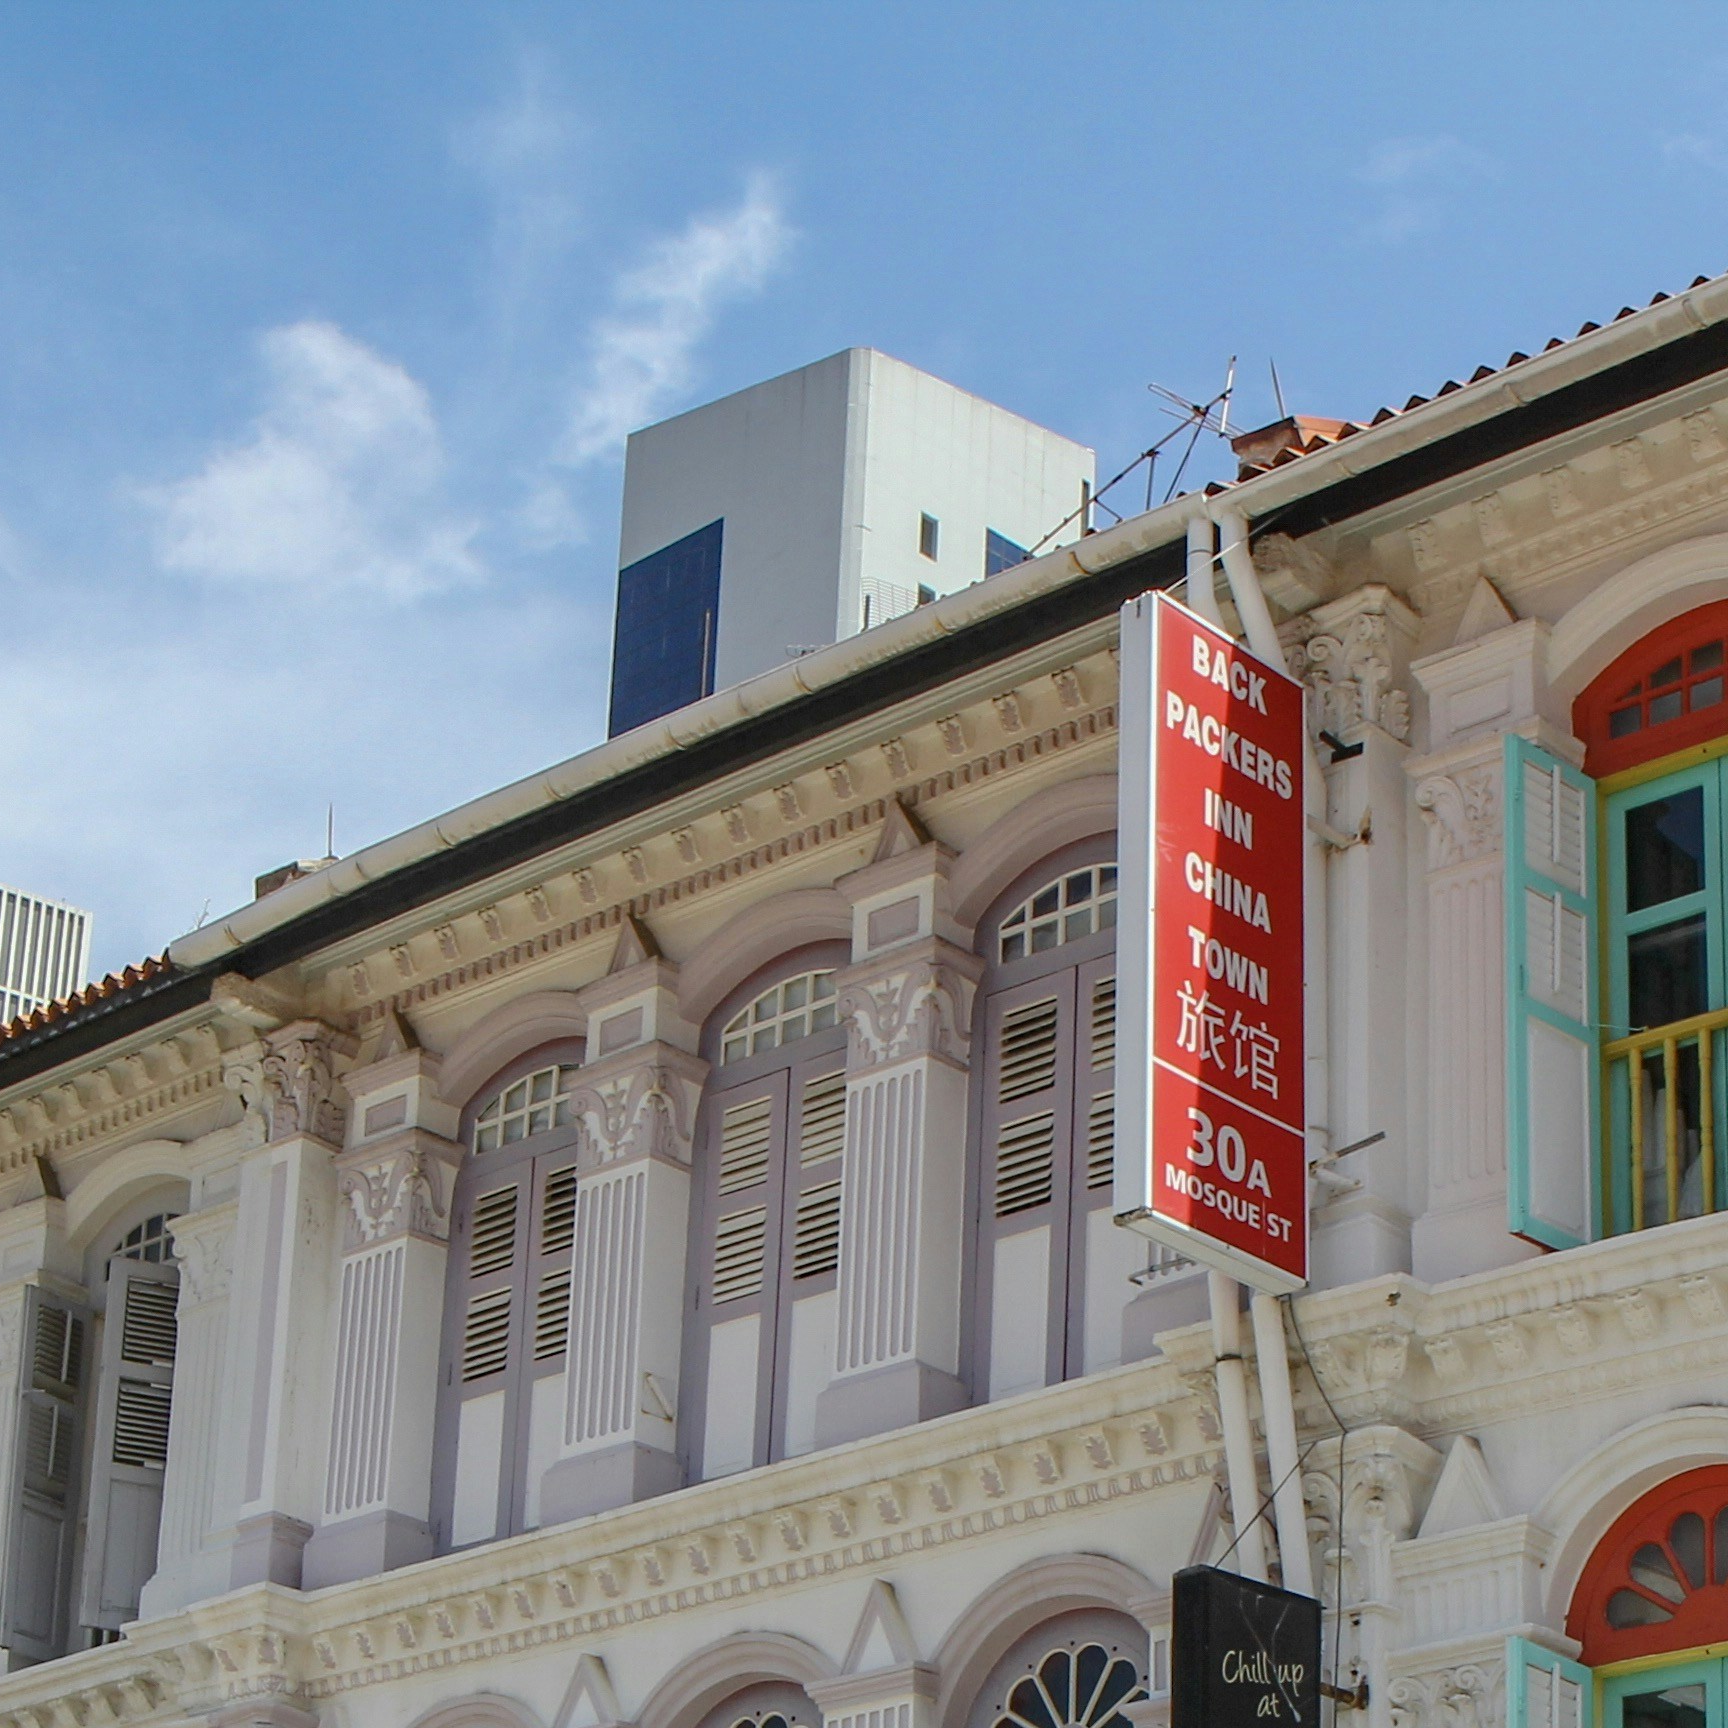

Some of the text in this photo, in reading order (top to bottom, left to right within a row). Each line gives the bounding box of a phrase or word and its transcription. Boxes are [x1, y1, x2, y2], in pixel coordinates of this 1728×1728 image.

[1192, 634, 1267, 717] BACK
[1166, 690, 1293, 800] PACKERS
[1204, 787, 1253, 850] INN
[1185, 852, 1272, 935] CHINA
[1187, 925, 1269, 1006] TOWN
[1176, 980, 1280, 1100] 旅馆
[1186, 1106, 1272, 1199] 30A
[1165, 1163, 1293, 1243] MOSQUE ST
[1222, 1650, 1304, 1697] Chill up
[1257, 1693, 1281, 1718] at
